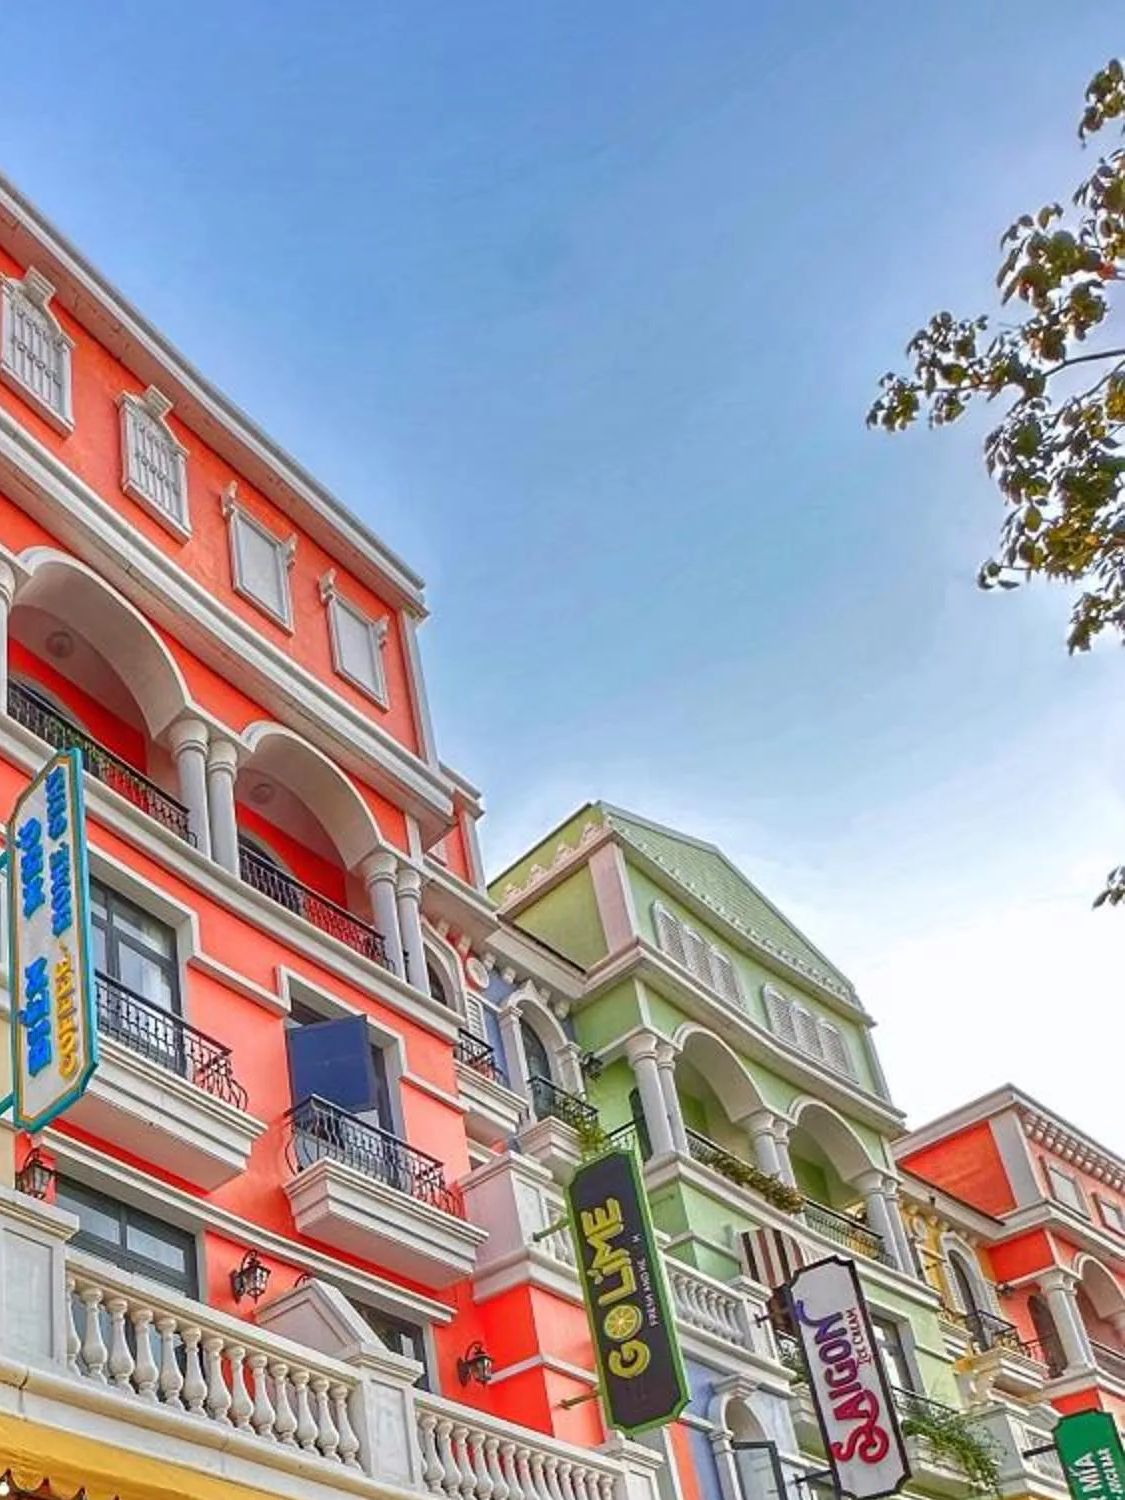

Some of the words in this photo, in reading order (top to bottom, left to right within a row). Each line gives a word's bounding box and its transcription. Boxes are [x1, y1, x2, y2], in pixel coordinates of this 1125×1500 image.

[846, 1308, 865, 1347] CREAM
[858, 1350, 872, 1366] ICE
[795, 1300, 889, 1464] SAIGON
[1069, 1453, 1102, 1493] MÍA
